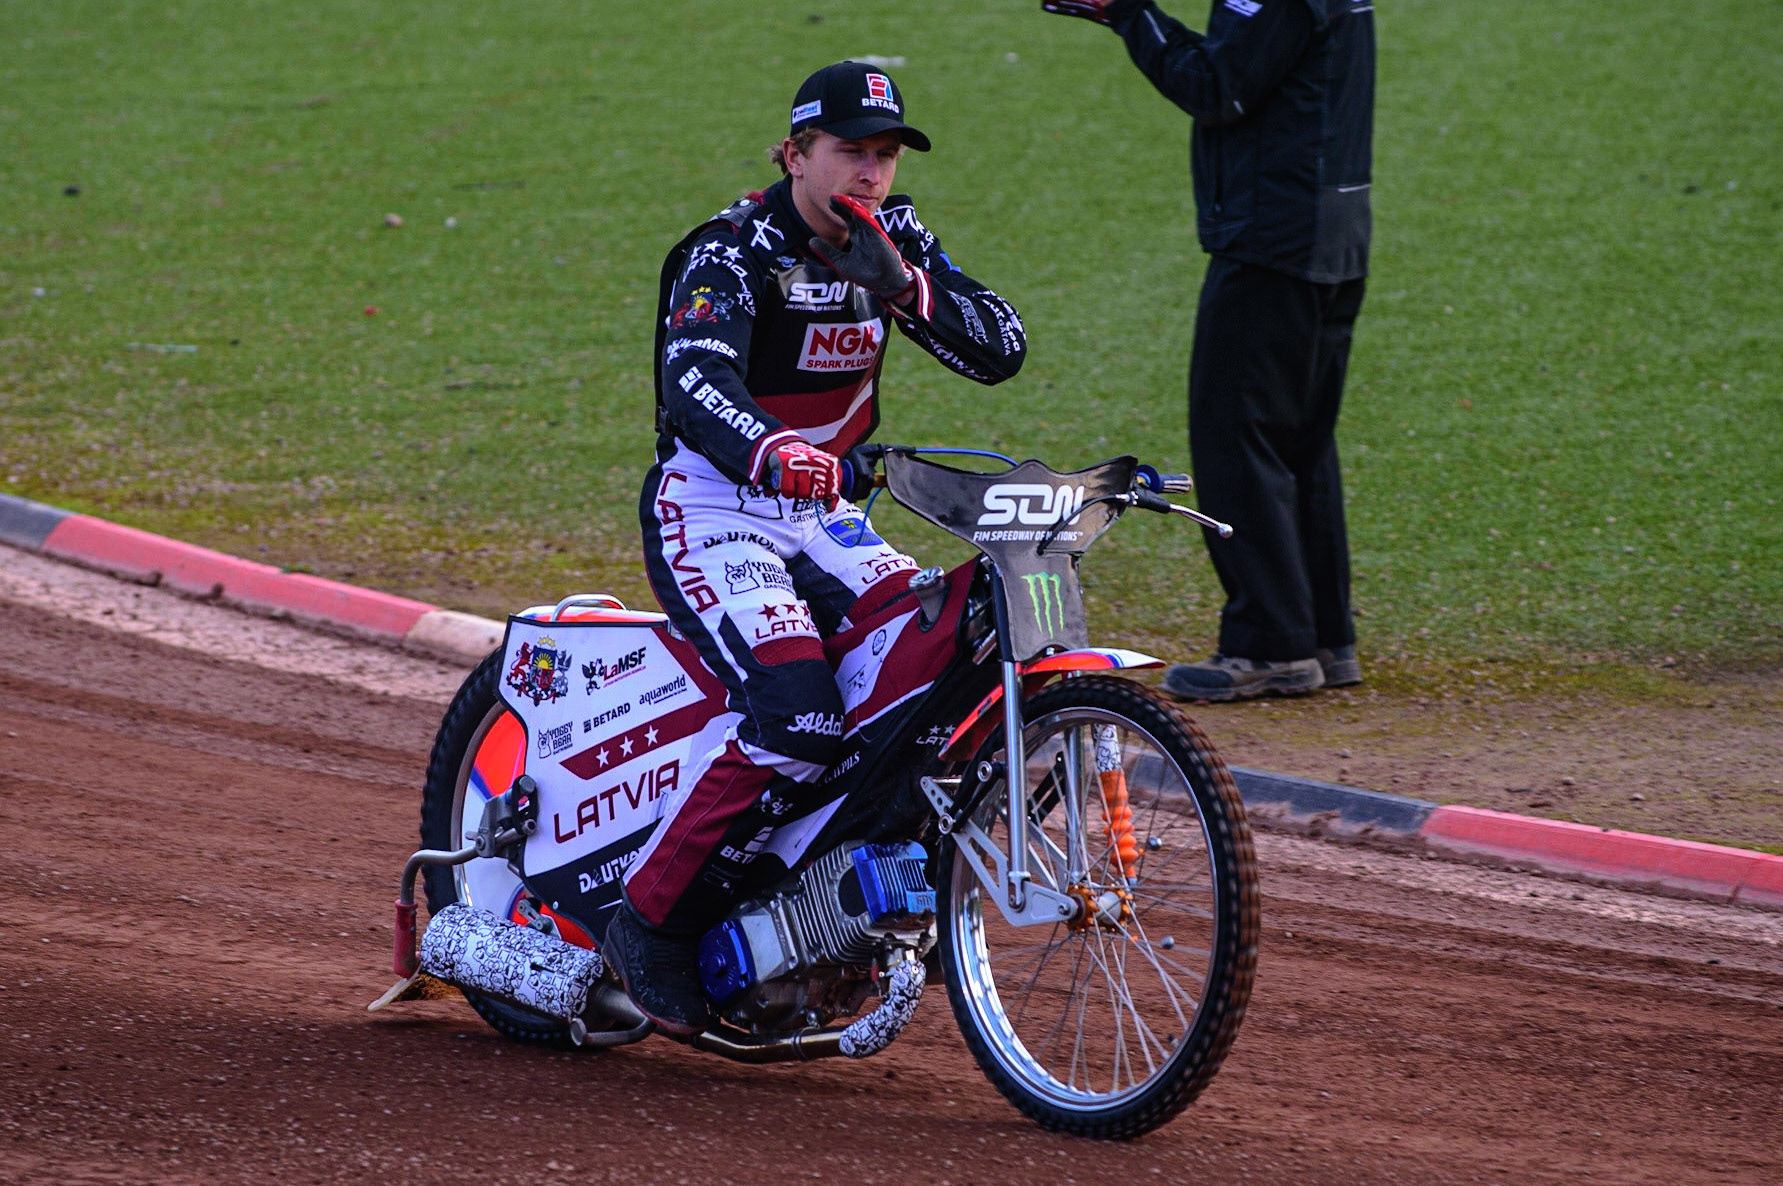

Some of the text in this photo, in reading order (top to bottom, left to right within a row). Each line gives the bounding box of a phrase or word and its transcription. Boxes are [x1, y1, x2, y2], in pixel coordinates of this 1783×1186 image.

[861, 98, 899, 114] BETARD
[788, 280, 849, 304] SON
[808, 325, 878, 356] NGK
[806, 359, 842, 368] SPARK
[692, 382, 766, 442] BETARD
[977, 483, 1085, 526] SON
[656, 471, 721, 614] LATVIA
[972, 530, 1079, 542] FIM SPEEDWAY OF NTIONS
[861, 558, 914, 585] LATV
[603, 646, 647, 681] LaMSF
[639, 674, 687, 705] aquaworld
[593, 702, 631, 728] BETARD
[787, 711, 845, 736] Alda
[916, 735, 950, 745] LAT
[553, 758, 681, 844] LATVIA
[720, 845, 756, 865] BET
